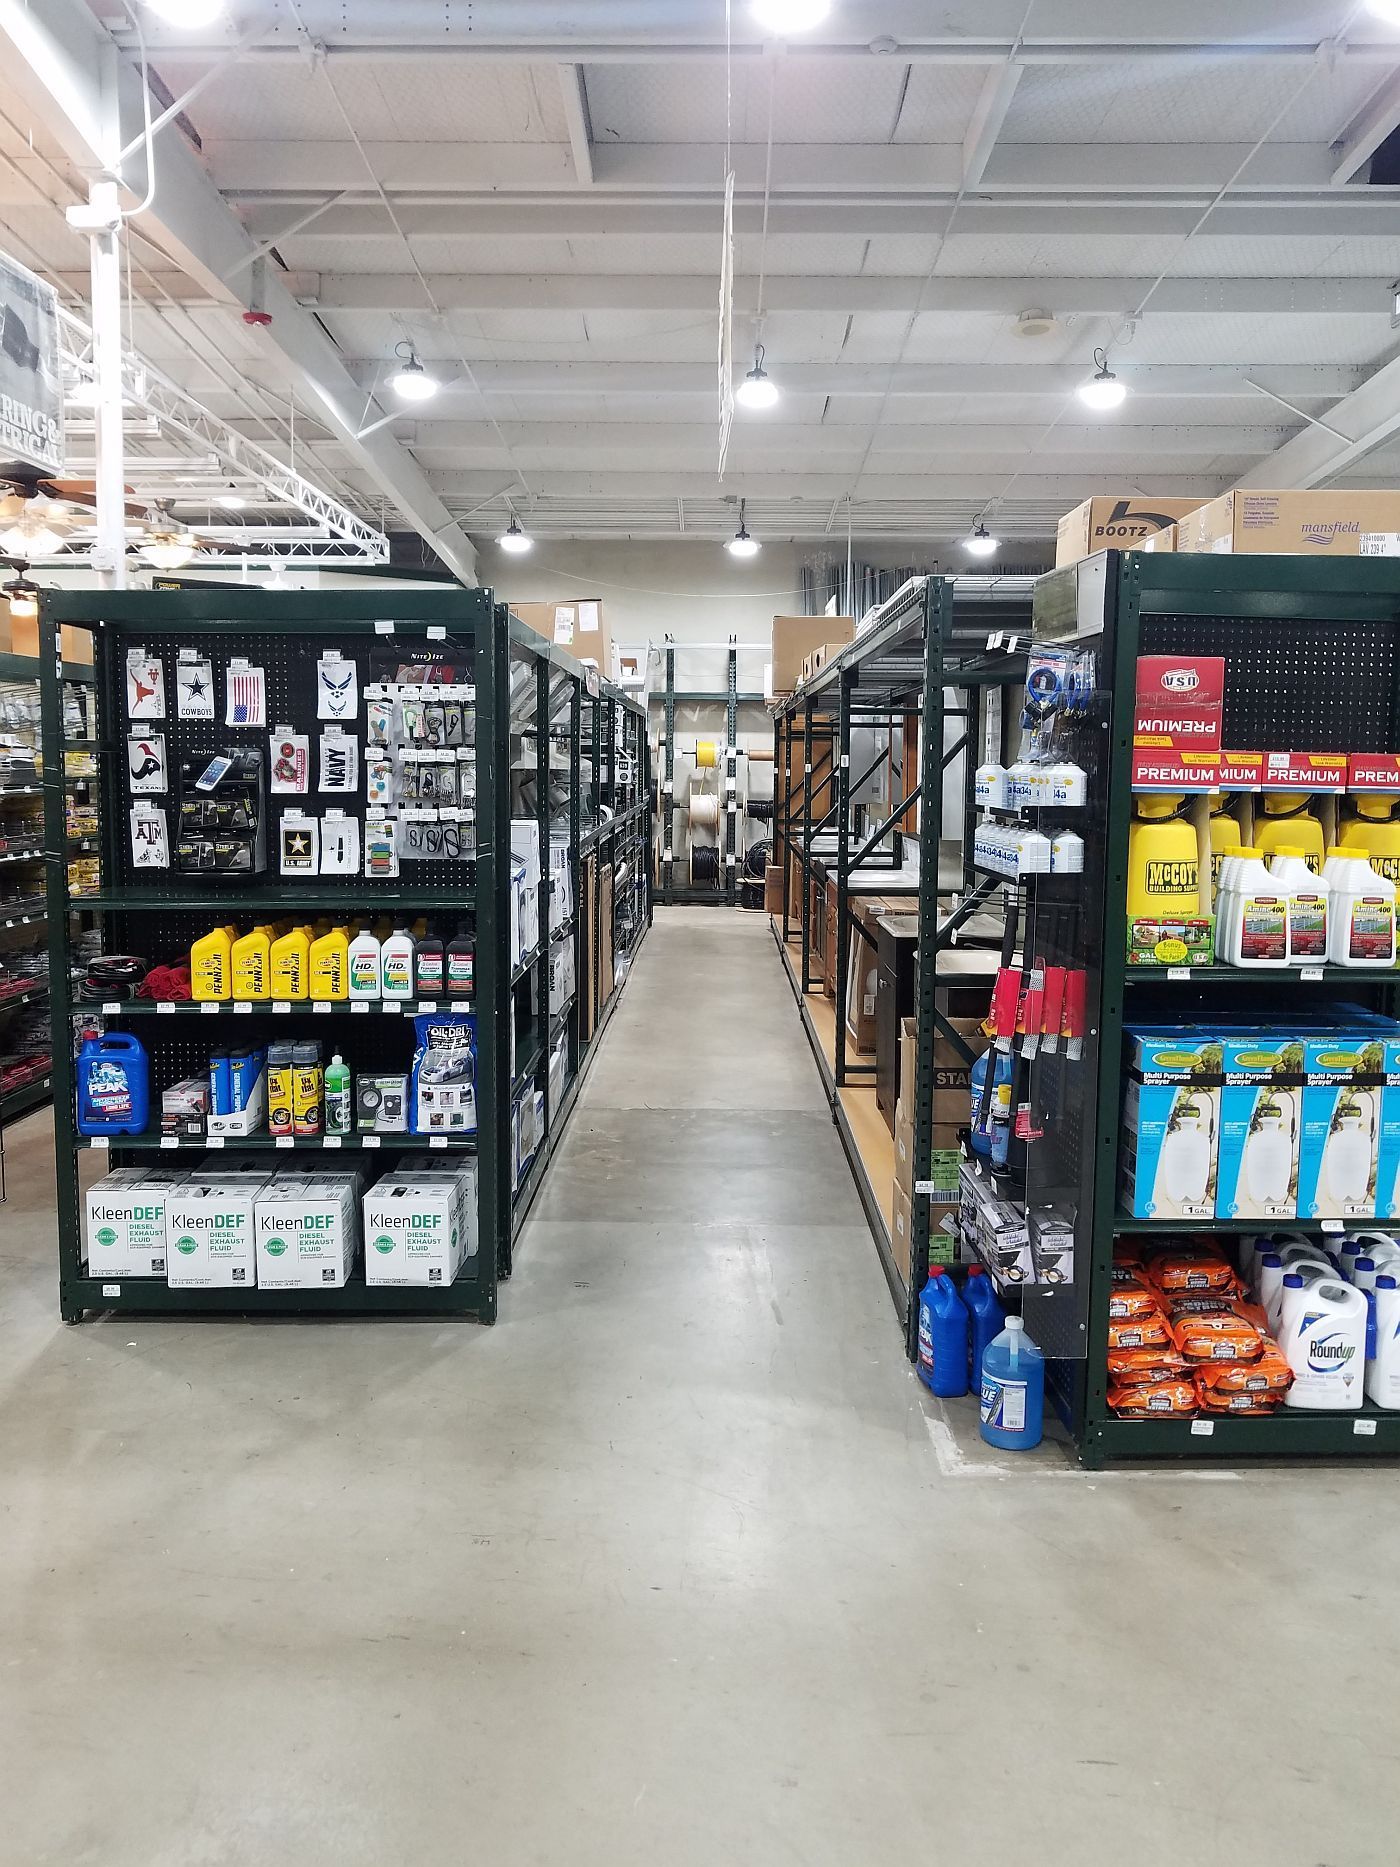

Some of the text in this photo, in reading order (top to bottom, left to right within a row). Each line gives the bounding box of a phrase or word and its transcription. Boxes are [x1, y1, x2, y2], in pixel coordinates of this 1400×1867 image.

[1095, 526, 1147, 536] BOOTZ
[1301, 522, 1360, 534] mansfield
[1165, 675, 1196, 686] USA
[181, 708, 212, 716] COWBOYS
[1137, 720, 1216, 733] PREMIUM
[328, 748, 346, 787] NAVY
[1137, 768, 1214, 781] PREMIUM
[1267, 769, 1340, 782] PREMIUM
[89, 1081, 128, 1096] PEAK
[91, 1206, 164, 1220] KleenDEF
[172, 1214, 245, 1229] KleenDEF
[261, 1215, 335, 1230] KleenDEF
[370, 1213, 442, 1228] KleenDEF
[1310, 1340, 1356, 1362] Roundup
